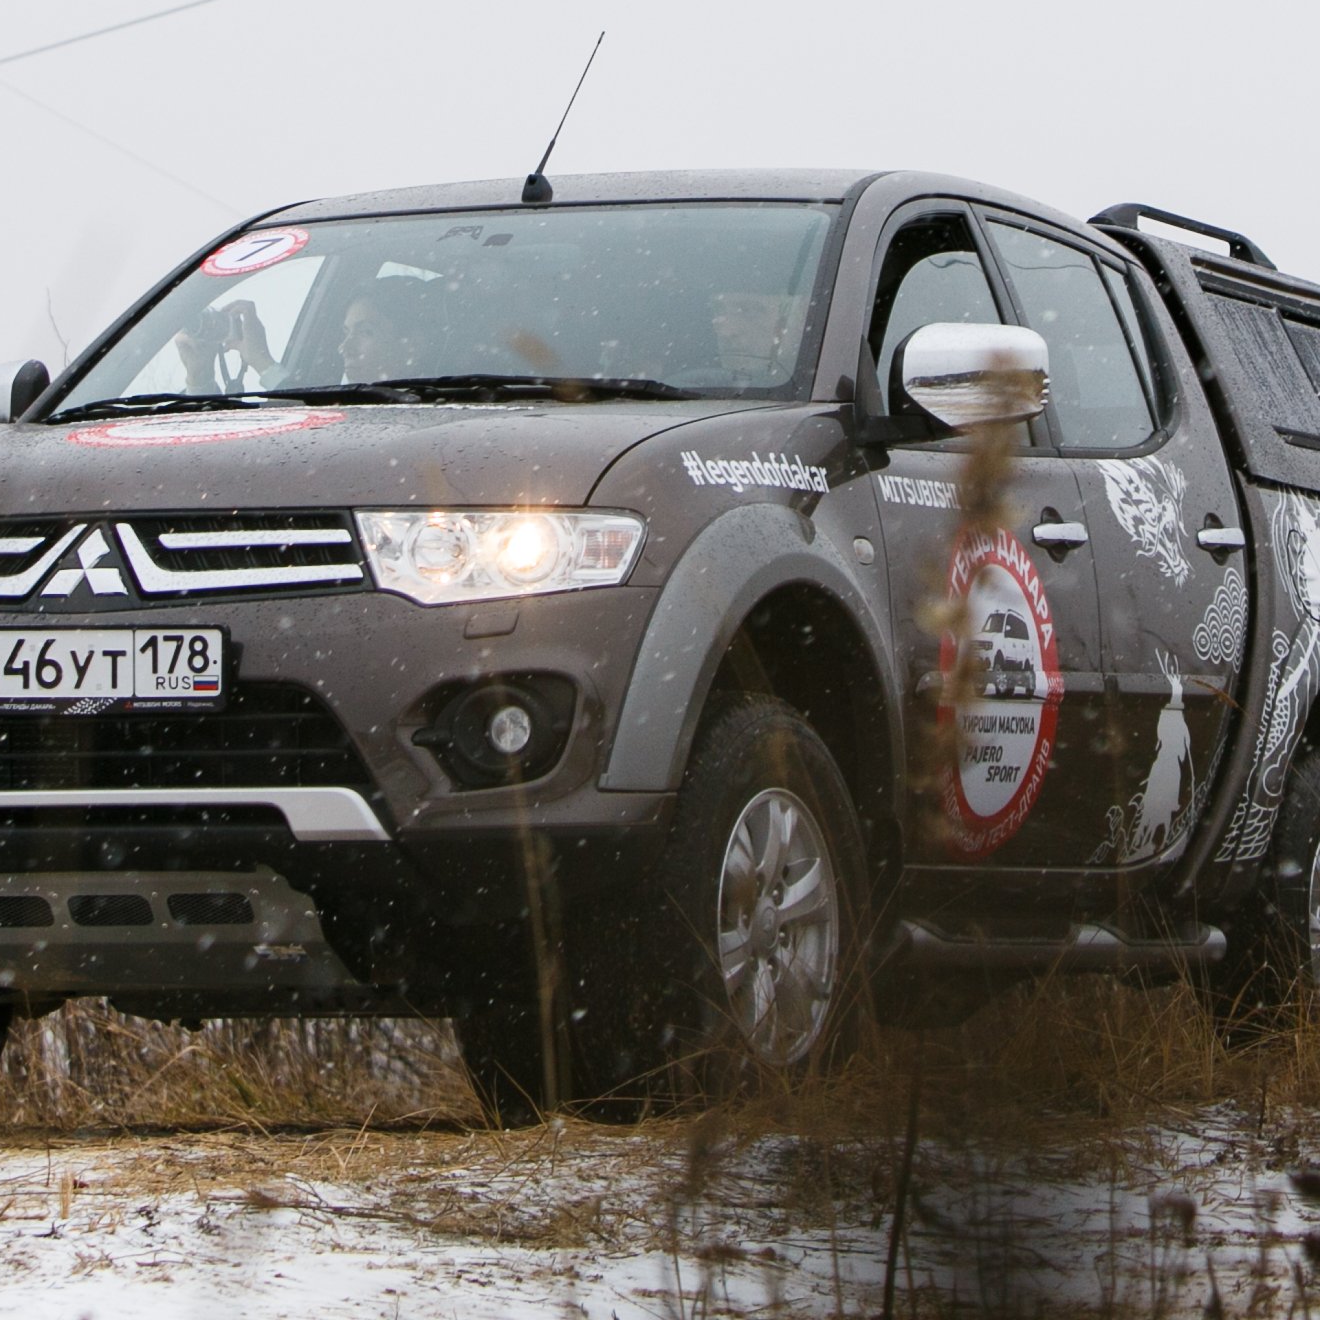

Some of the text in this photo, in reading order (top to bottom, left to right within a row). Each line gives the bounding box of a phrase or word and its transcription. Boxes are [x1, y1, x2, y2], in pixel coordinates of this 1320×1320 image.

[235, 237, 285, 262] 7
[681, 450, 830, 494] #legendofdakar
[878, 474, 962, 510] MITSUBISHI
[996, 526, 1053, 650] ДАКАРА
[139, 635, 210, 674] 178
[156, 677, 191, 690] RUS
[998, 715, 1035, 735] МАСУОКА
[964, 745, 1004, 764] PAJERO
[986, 765, 1021, 783] SPORT
